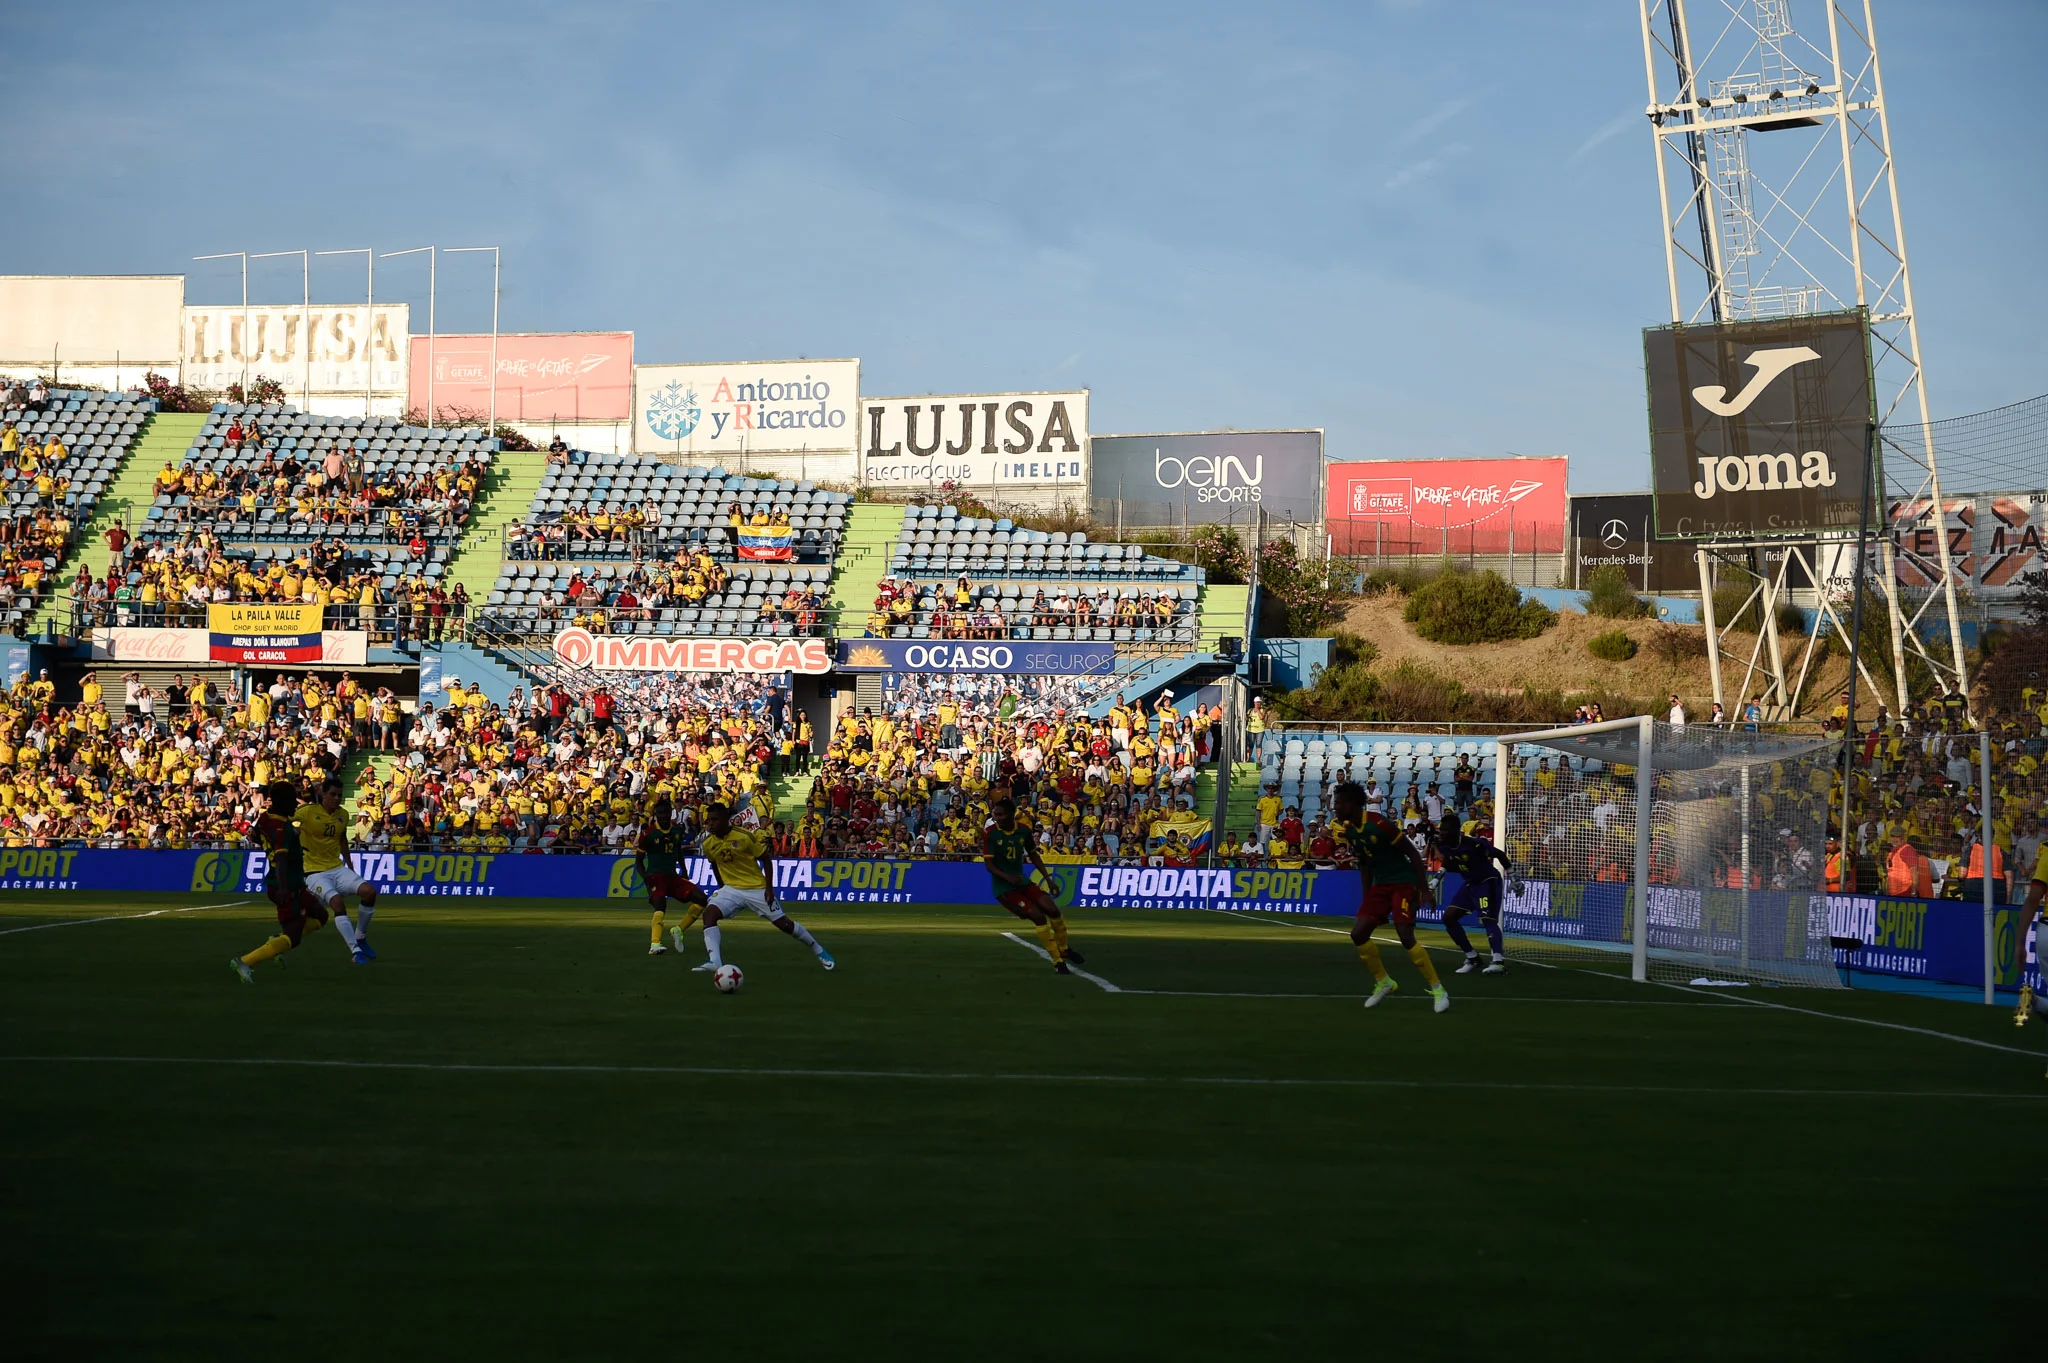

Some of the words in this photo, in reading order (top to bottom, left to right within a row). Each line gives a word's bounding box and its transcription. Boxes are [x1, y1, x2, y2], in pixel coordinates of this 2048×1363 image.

[190, 313, 399, 363] LUJISA
[451, 368, 483, 377] GETAFE
[711, 374, 830, 402] Antonio
[711, 412, 730, 439] y
[733, 402, 846, 430] Ricardo
[867, 401, 1080, 457] LUJISA
[867, 464, 972, 481] ELECTROCLUB
[1004, 462, 1080, 478] IMELCO
[1198, 486, 1262, 503] SPORTS
[1461, 485, 1502, 508] GETAFE
[1370, 497, 1404, 508] GETAFE
[231, 610, 243, 621] LA
[246, 610, 271, 621] PAILA
[274, 609, 301, 620] VALLE
[231, 636, 252, 647] AREPAS
[253, 635, 270, 647] DOÑA
[270, 636, 299, 647] BLANQUITA
[243, 651, 257, 660] GOL
[258, 651, 287, 661] CARACOL
[597, 641, 828, 670] IMMERGAS
[905, 645, 1013, 669] OCASO
[1025, 653, 1110, 669] SEGUROS
[323, 824, 336, 837] 20
[1006, 846, 1017, 860] 21
[380, 884, 496, 896] MANAGEMENT
[797, 890, 913, 903] MANAGEMENT
[1121, 899, 1207, 910] FOOTBALL
[1217, 900, 1319, 914] MANAGEMENT
[1400, 897, 1409, 912] 4
[1479, 896, 1489, 909] 16
[1866, 950, 1929, 975] MANAGEMENT
